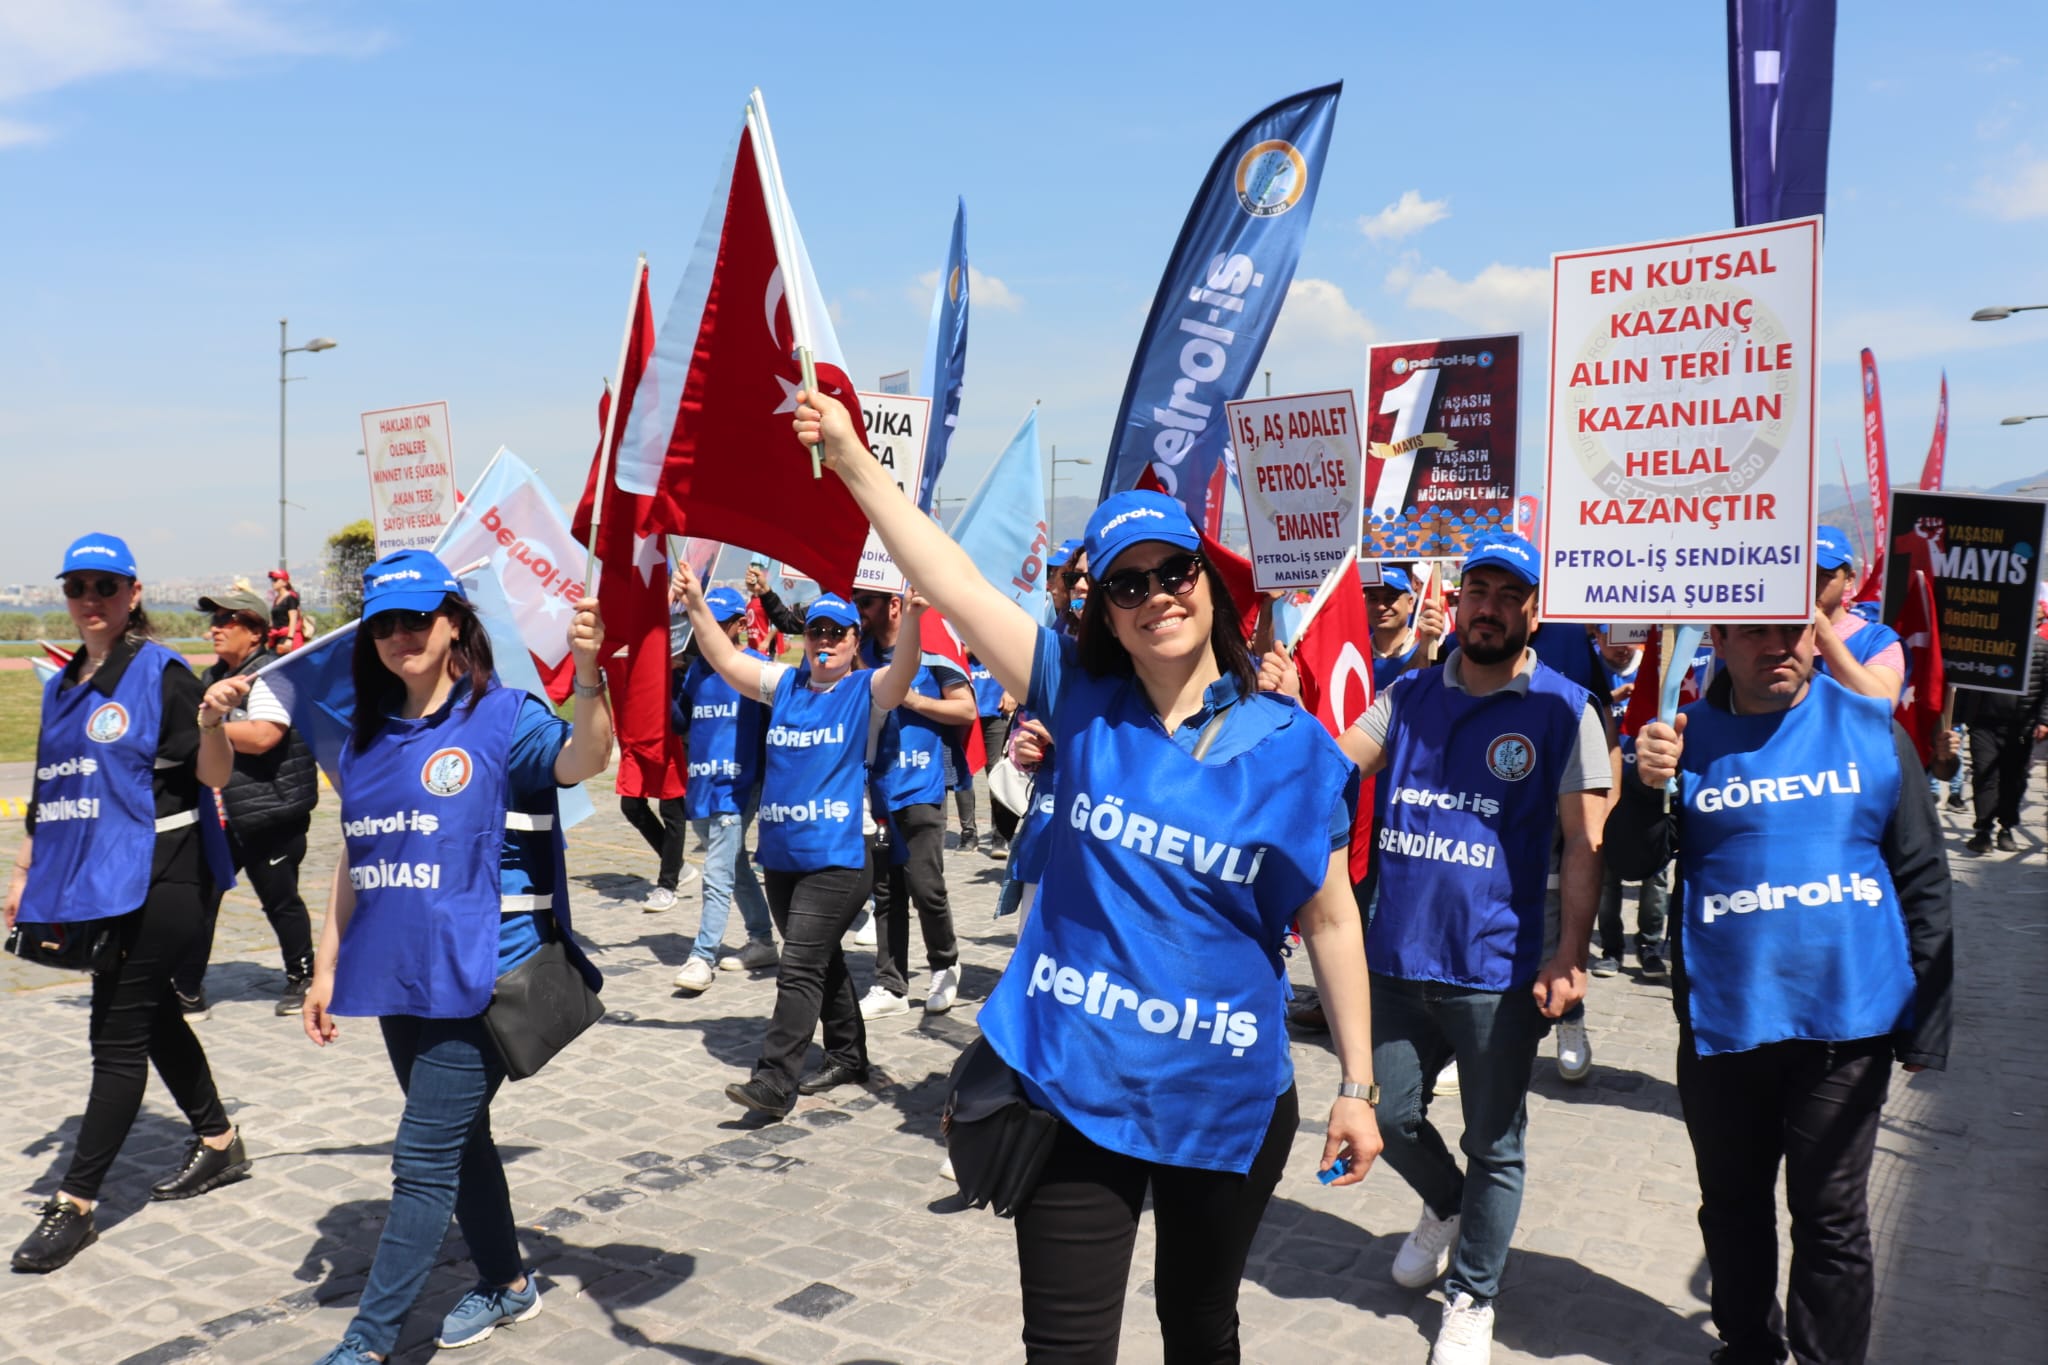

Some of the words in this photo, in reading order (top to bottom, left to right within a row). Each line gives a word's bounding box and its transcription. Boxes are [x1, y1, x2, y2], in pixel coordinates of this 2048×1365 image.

[1590, 266, 1633, 294] EN
[1646, 247, 1777, 288] KUTSAL
[1610, 298, 1753, 338] KAZANÇ
[1568, 357, 1648, 387] ALIN
[1661, 341, 1730, 380] TERİ
[1744, 338, 1793, 373] İLE
[1237, 410, 1260, 451] İŞ,
[1264, 413, 1284, 448] AŞ
[1289, 407, 1347, 439] ADALET
[1578, 393, 1782, 433] KAZANILAN
[1392, 435, 1424, 456] MAYIS
[1625, 447, 1731, 477] HELAL
[1256, 453, 1346, 495] PETROL-İŞE
[1276, 511, 1340, 541] EMANET
[1579, 493, 1777, 530] KAZANÇTIR
[1949, 524, 2004, 546] YAŞASIN
[1257, 550, 1311, 565] PETROL-İŞ
[1275, 566, 1319, 582] MANİSA
[1554, 544, 1667, 573] PETROL-İŞ
[1675, 541, 1801, 567] SENDİKASI
[1934, 545, 2028, 585] MAYIS
[1584, 579, 1676, 603] MANİSA
[1684, 578, 1765, 608] ŞUBESİ
[1946, 585, 1999, 606] YAŞASIN
[1696, 762, 1861, 813] GÖREVLİ
[1070, 792, 1267, 884] GÖREVLİ
[1378, 827, 1496, 869] SENDİKASI
[1703, 873, 1883, 923] petrol-iş
[1027, 953, 1258, 1058] petrol-iş
